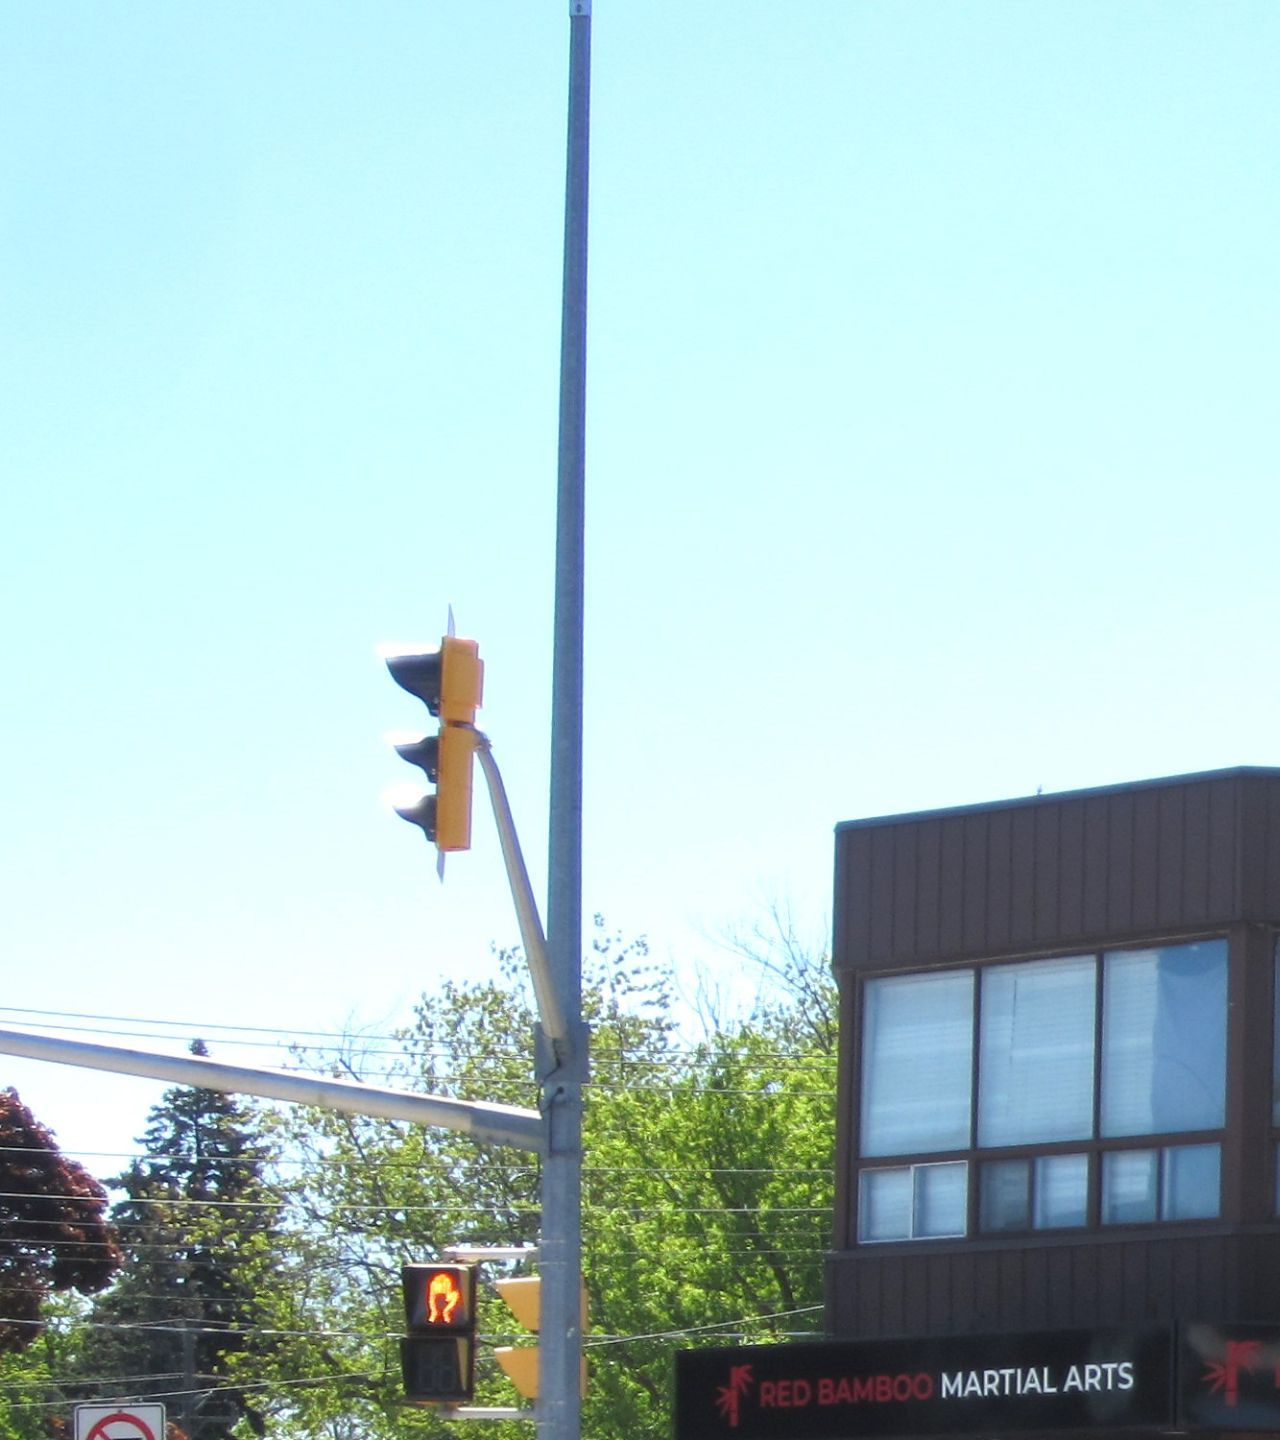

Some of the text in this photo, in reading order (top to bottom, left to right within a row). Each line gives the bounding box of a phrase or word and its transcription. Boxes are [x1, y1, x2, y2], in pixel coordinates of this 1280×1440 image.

[760, 1361, 1135, 1408] RED BAMBOO MARTIAL ARTS
